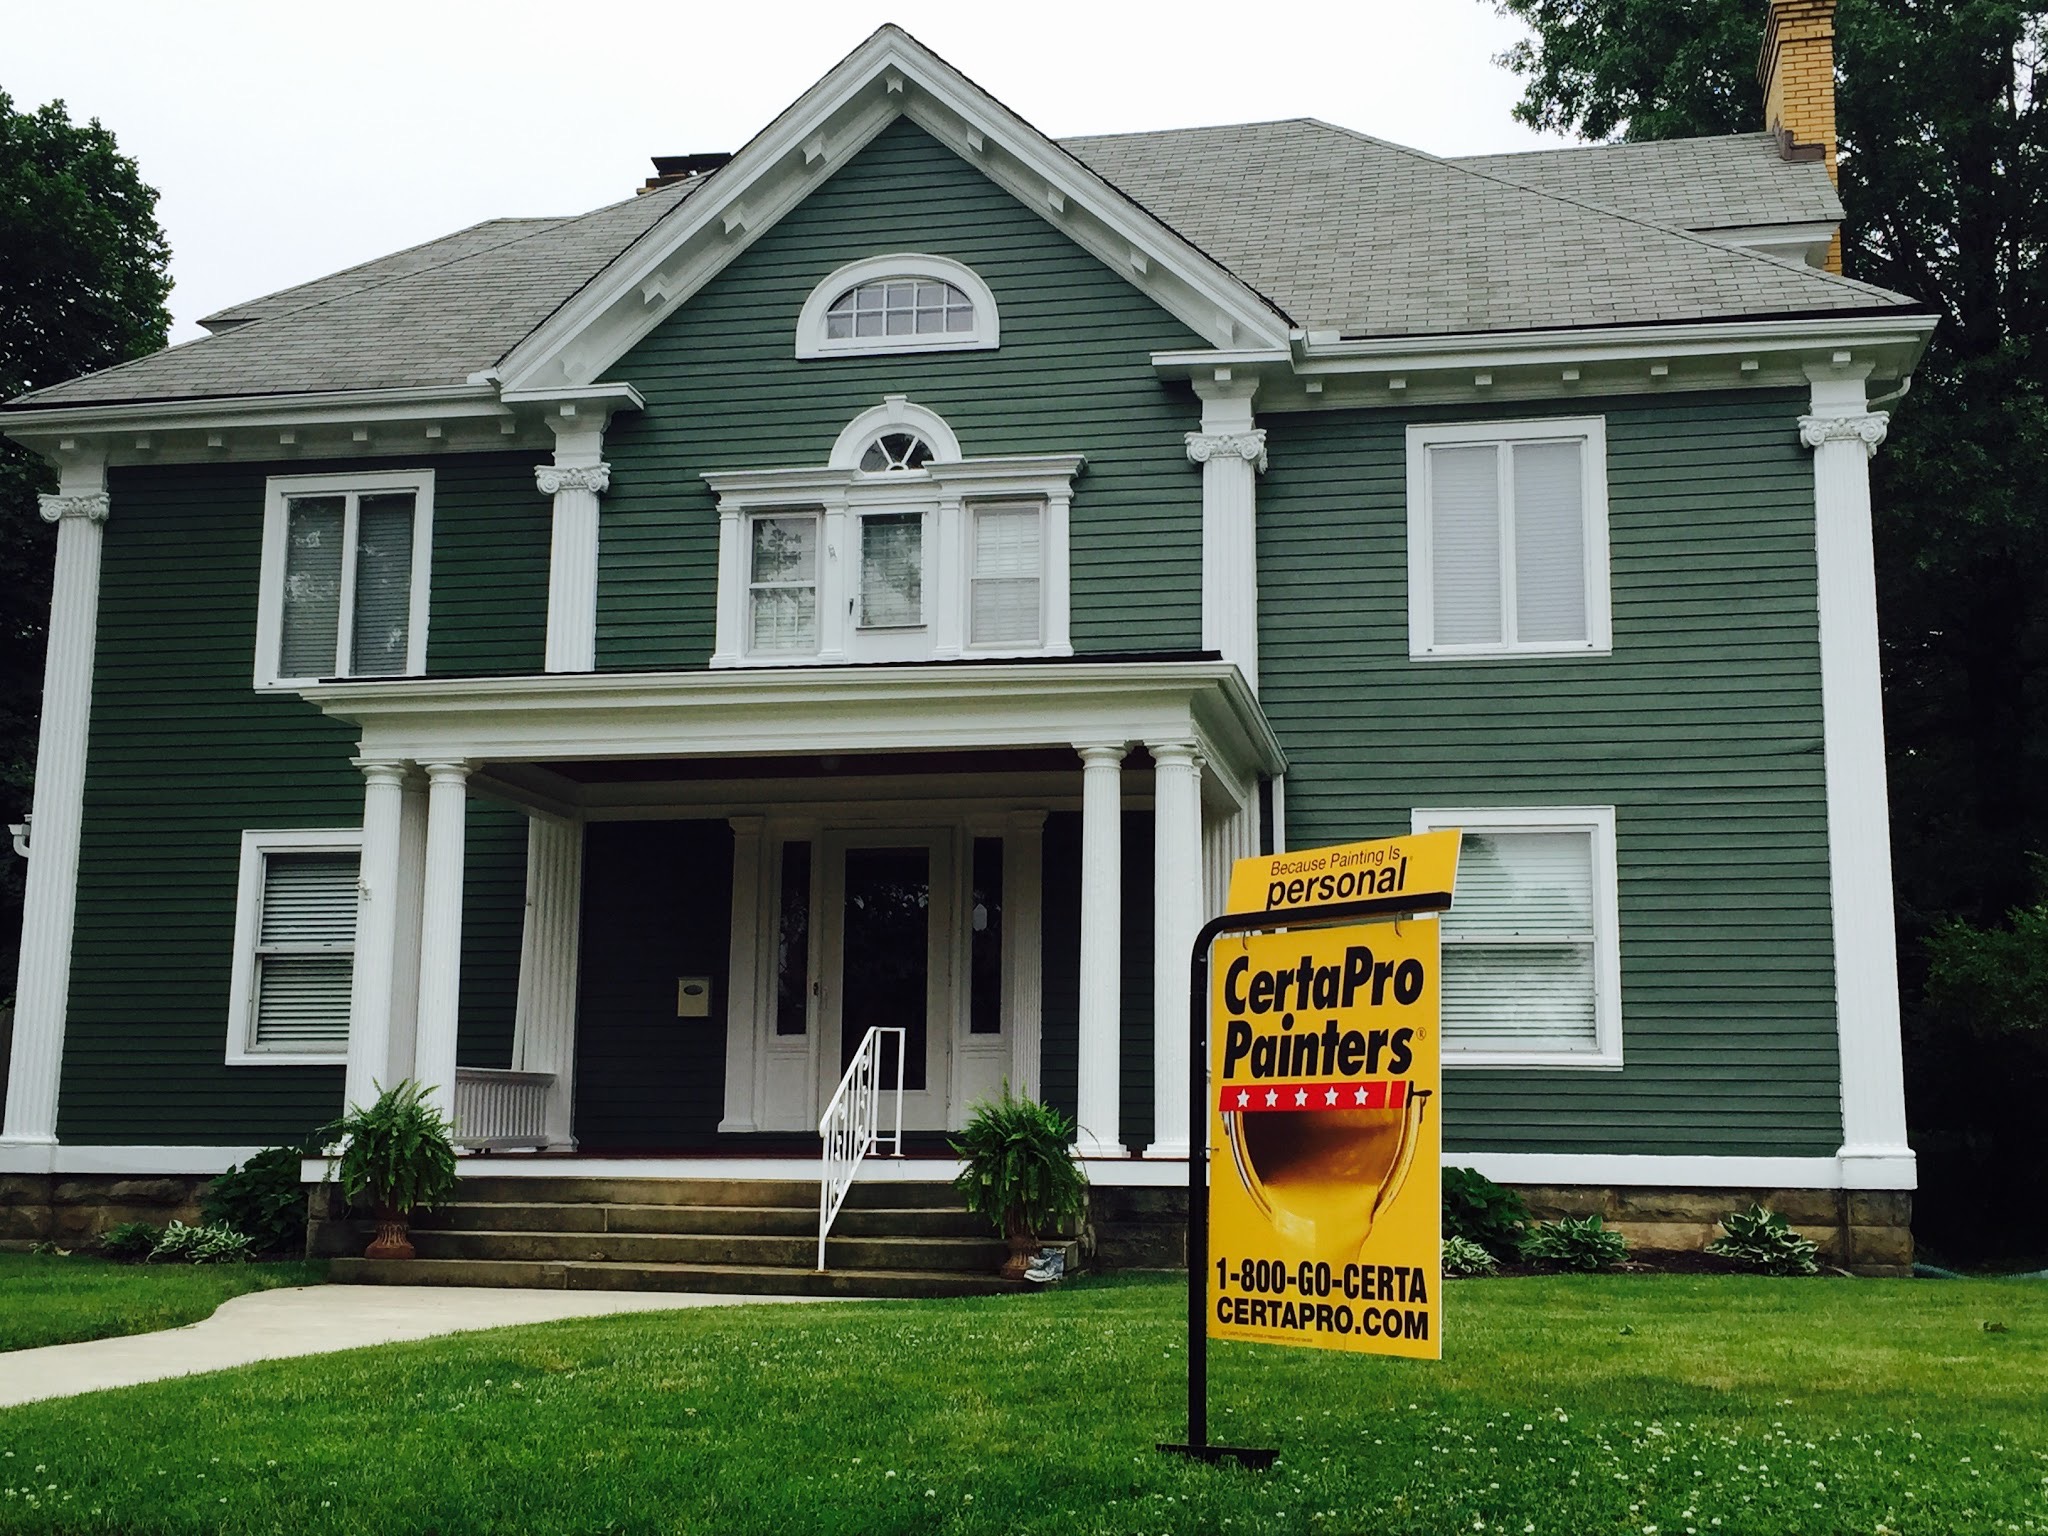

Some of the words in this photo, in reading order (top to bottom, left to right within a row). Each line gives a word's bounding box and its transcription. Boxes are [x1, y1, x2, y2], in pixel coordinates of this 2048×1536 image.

[1266, 857, 1407, 910] personal
[1270, 858, 1326, 876] Because
[1330, 849, 1384, 869] Painting
[1388, 846, 1401, 860] Is
[1225, 946, 1424, 1015] CertaPro
[1216, 1257, 1428, 1303] 1-800-GO-CERTA
[1217, 1296, 1429, 1340] CERTAPRO.COM
